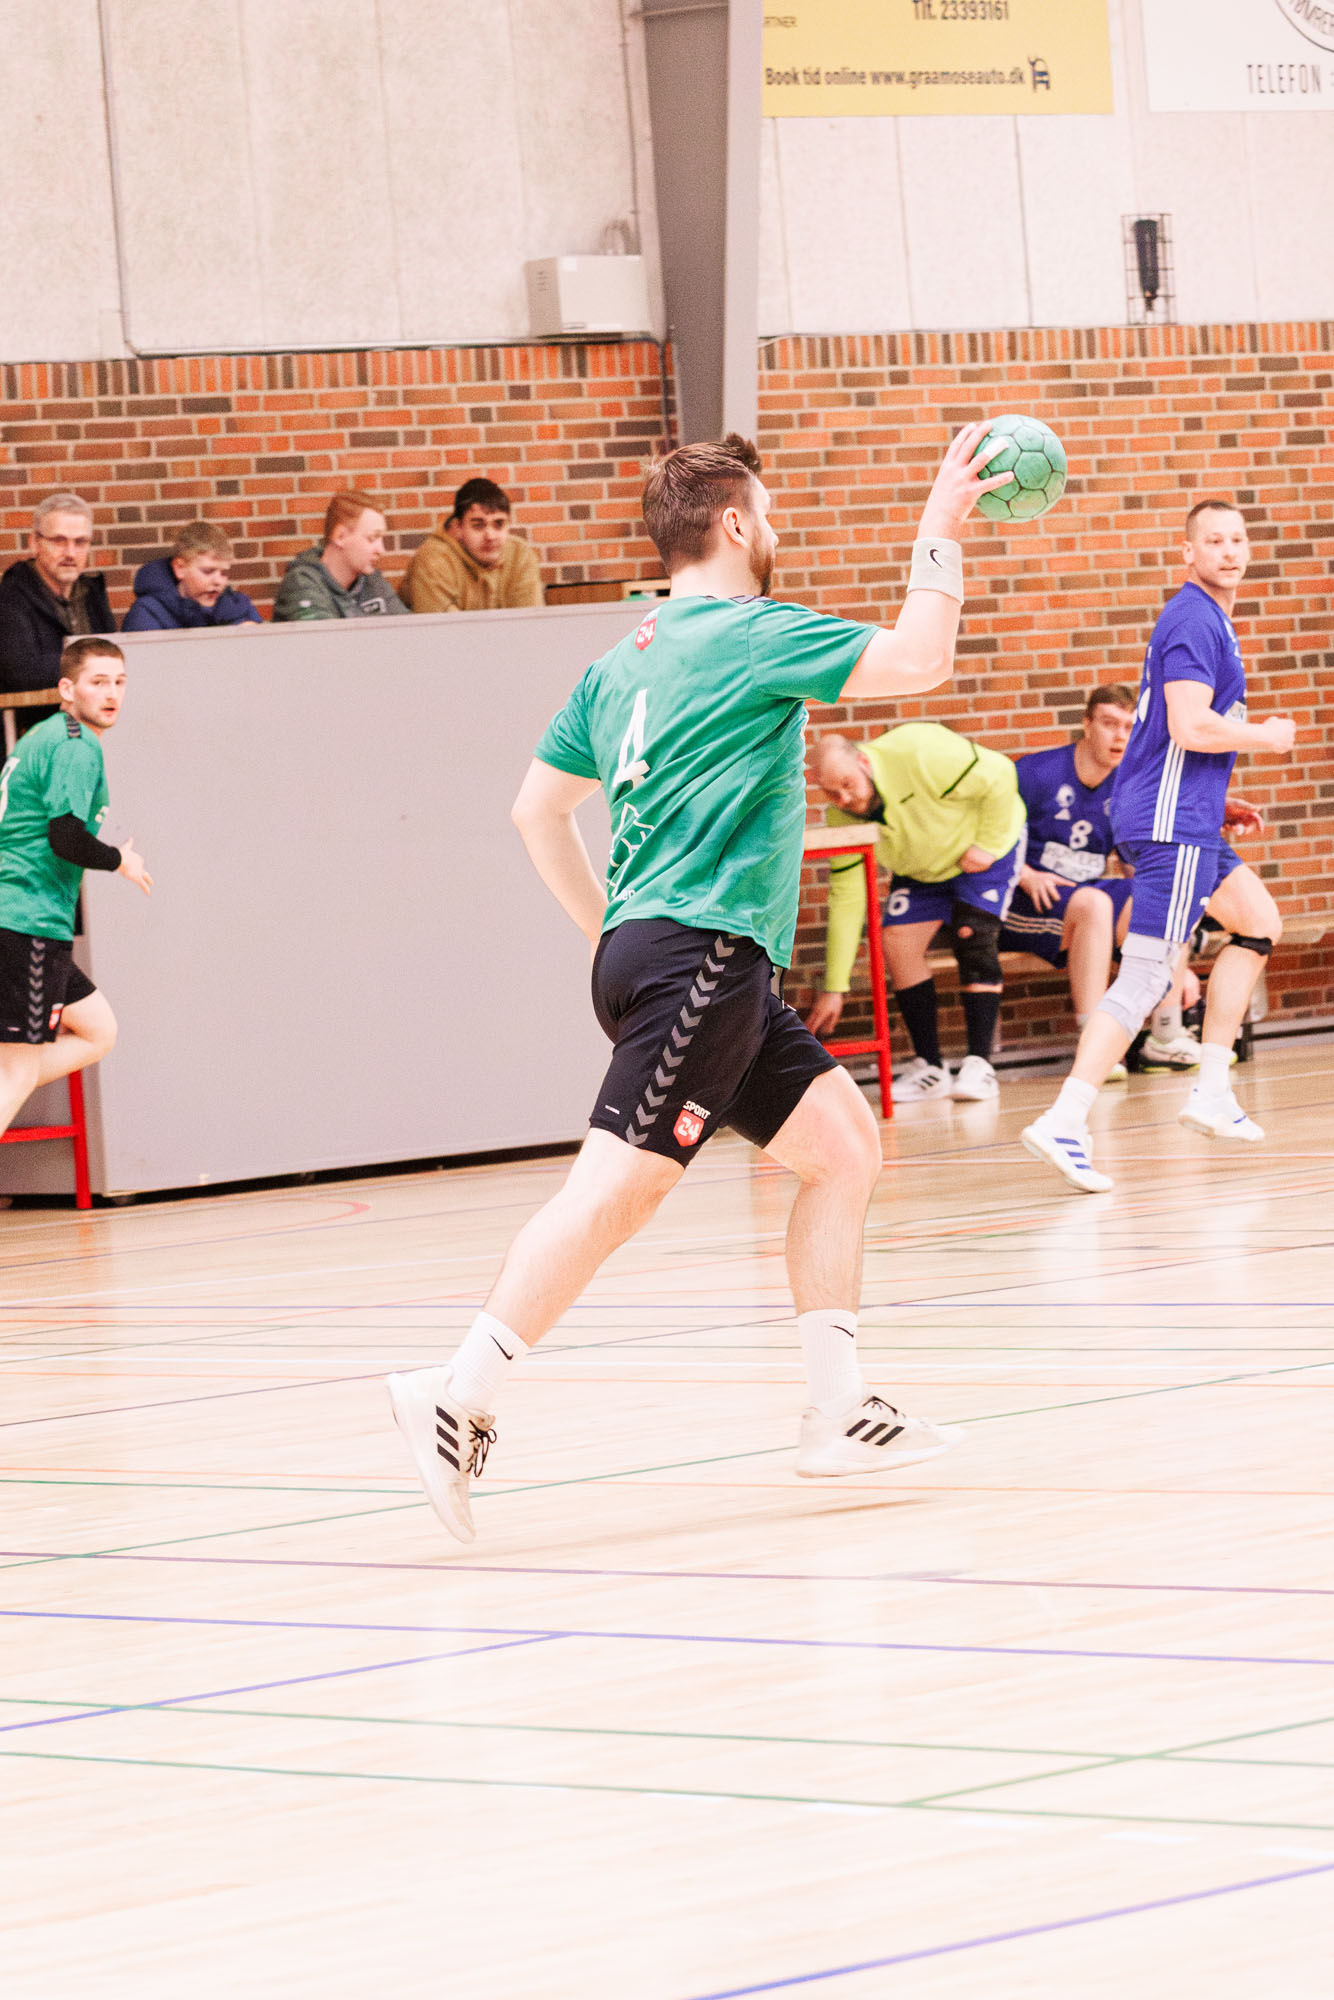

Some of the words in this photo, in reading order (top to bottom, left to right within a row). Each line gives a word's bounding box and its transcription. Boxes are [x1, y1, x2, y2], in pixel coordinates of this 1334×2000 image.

[765, 67, 800, 85] Book
[802, 67, 820, 85] tid
[825, 67, 866, 85] online
[1246, 63, 1322, 94] TELEFON
[612, 688, 650, 791] 4
[1069, 819, 1093, 849] 8
[887, 887, 910, 917] 6
[682, 1100, 711, 1120] SPORT
[677, 1116, 700, 1141] 24
